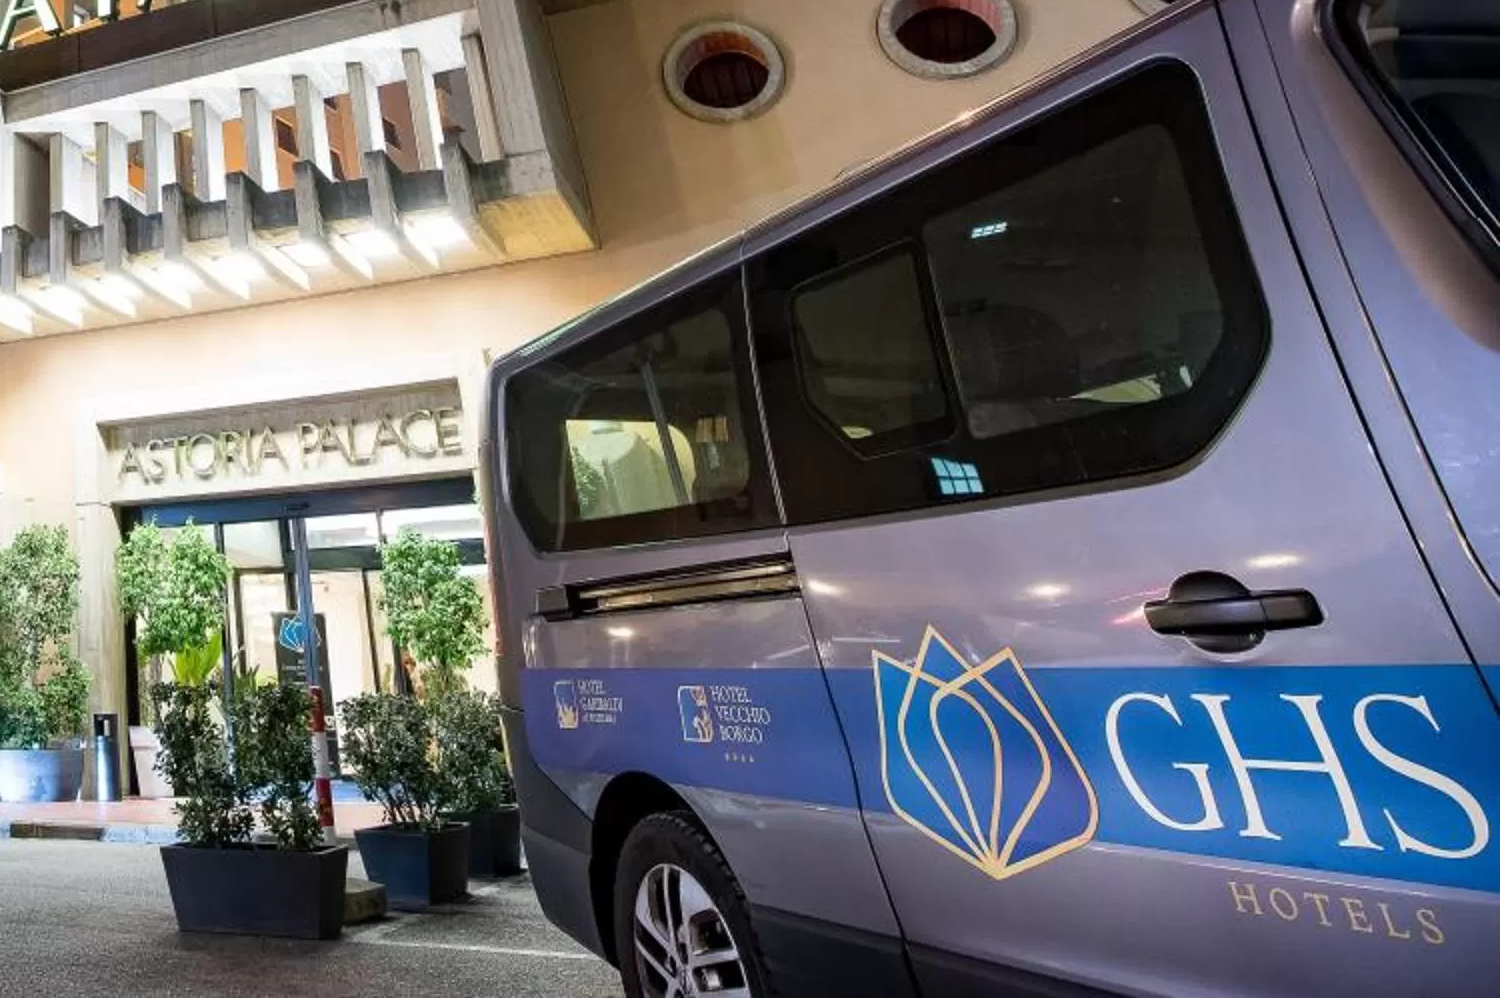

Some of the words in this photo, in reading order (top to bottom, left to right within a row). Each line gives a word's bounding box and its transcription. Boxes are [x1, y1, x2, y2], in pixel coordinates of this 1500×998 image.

[116, 424, 290, 487] ASTORIA
[297, 406, 464, 472] PALACE
[708, 685, 753, 703] HOTEL
[714, 704, 772, 725] VECCHIO
[719, 724, 764, 745] BORGO
[1104, 691, 1490, 860] GHS
[1226, 880, 1446, 946] HOTELS
